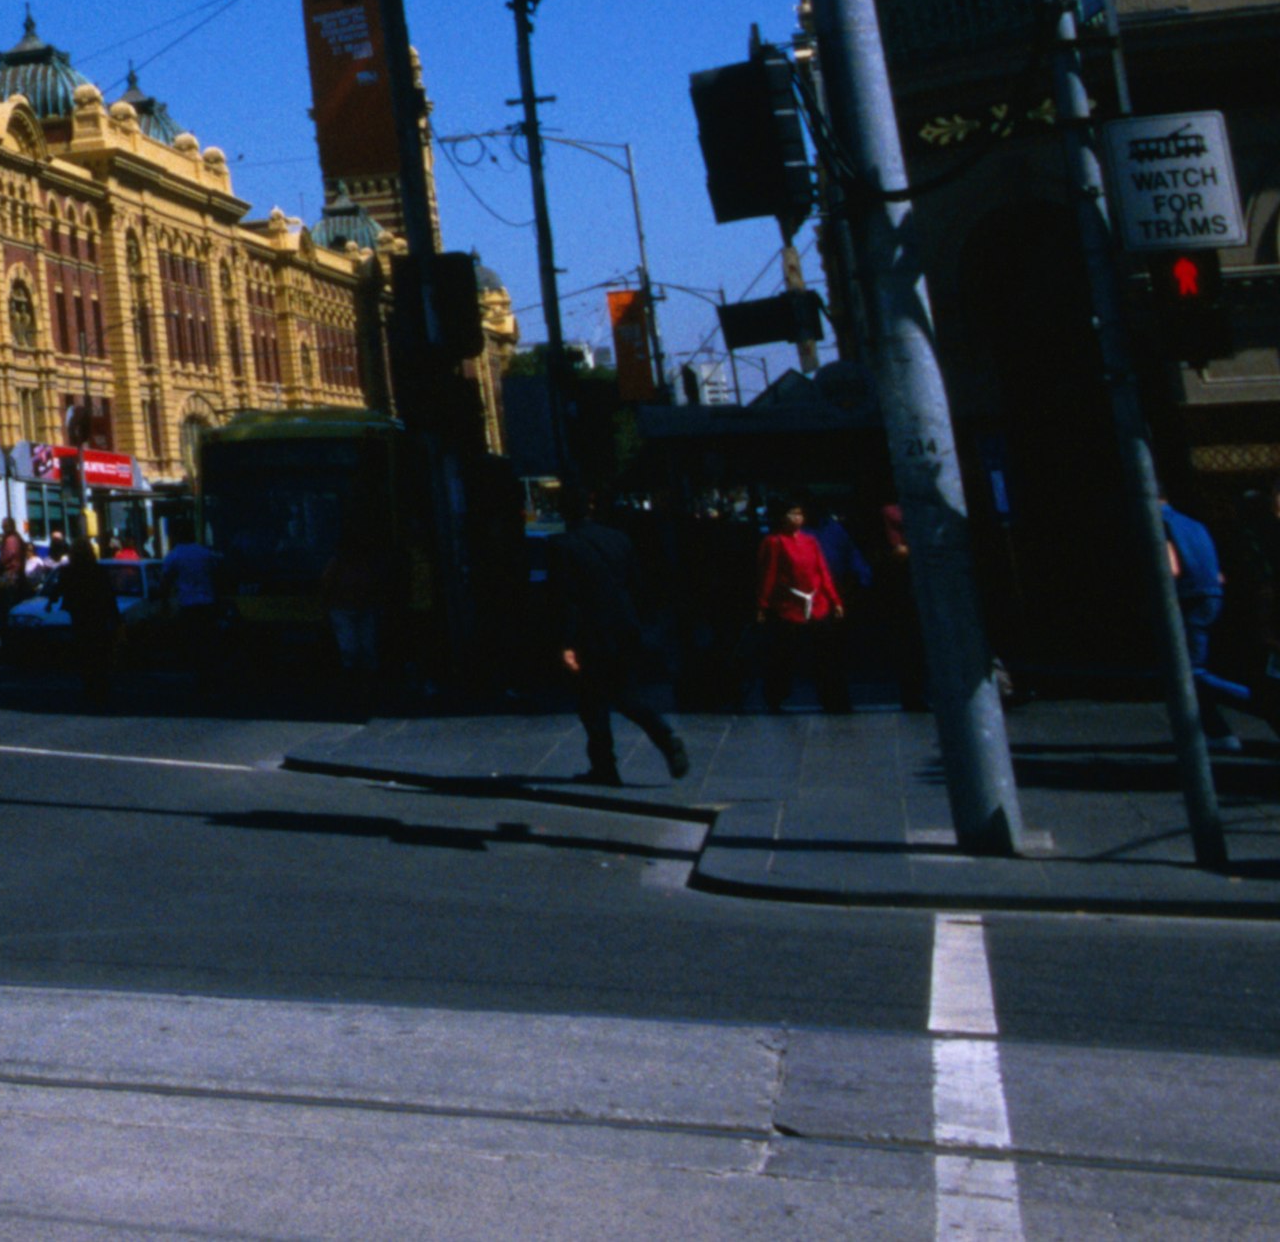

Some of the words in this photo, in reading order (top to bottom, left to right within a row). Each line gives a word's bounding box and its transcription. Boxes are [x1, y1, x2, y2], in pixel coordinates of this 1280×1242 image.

[1130, 165, 1219, 192] WATCH
[1151, 192, 1204, 215] FOR
[1138, 215, 1229, 239] TRAMS
